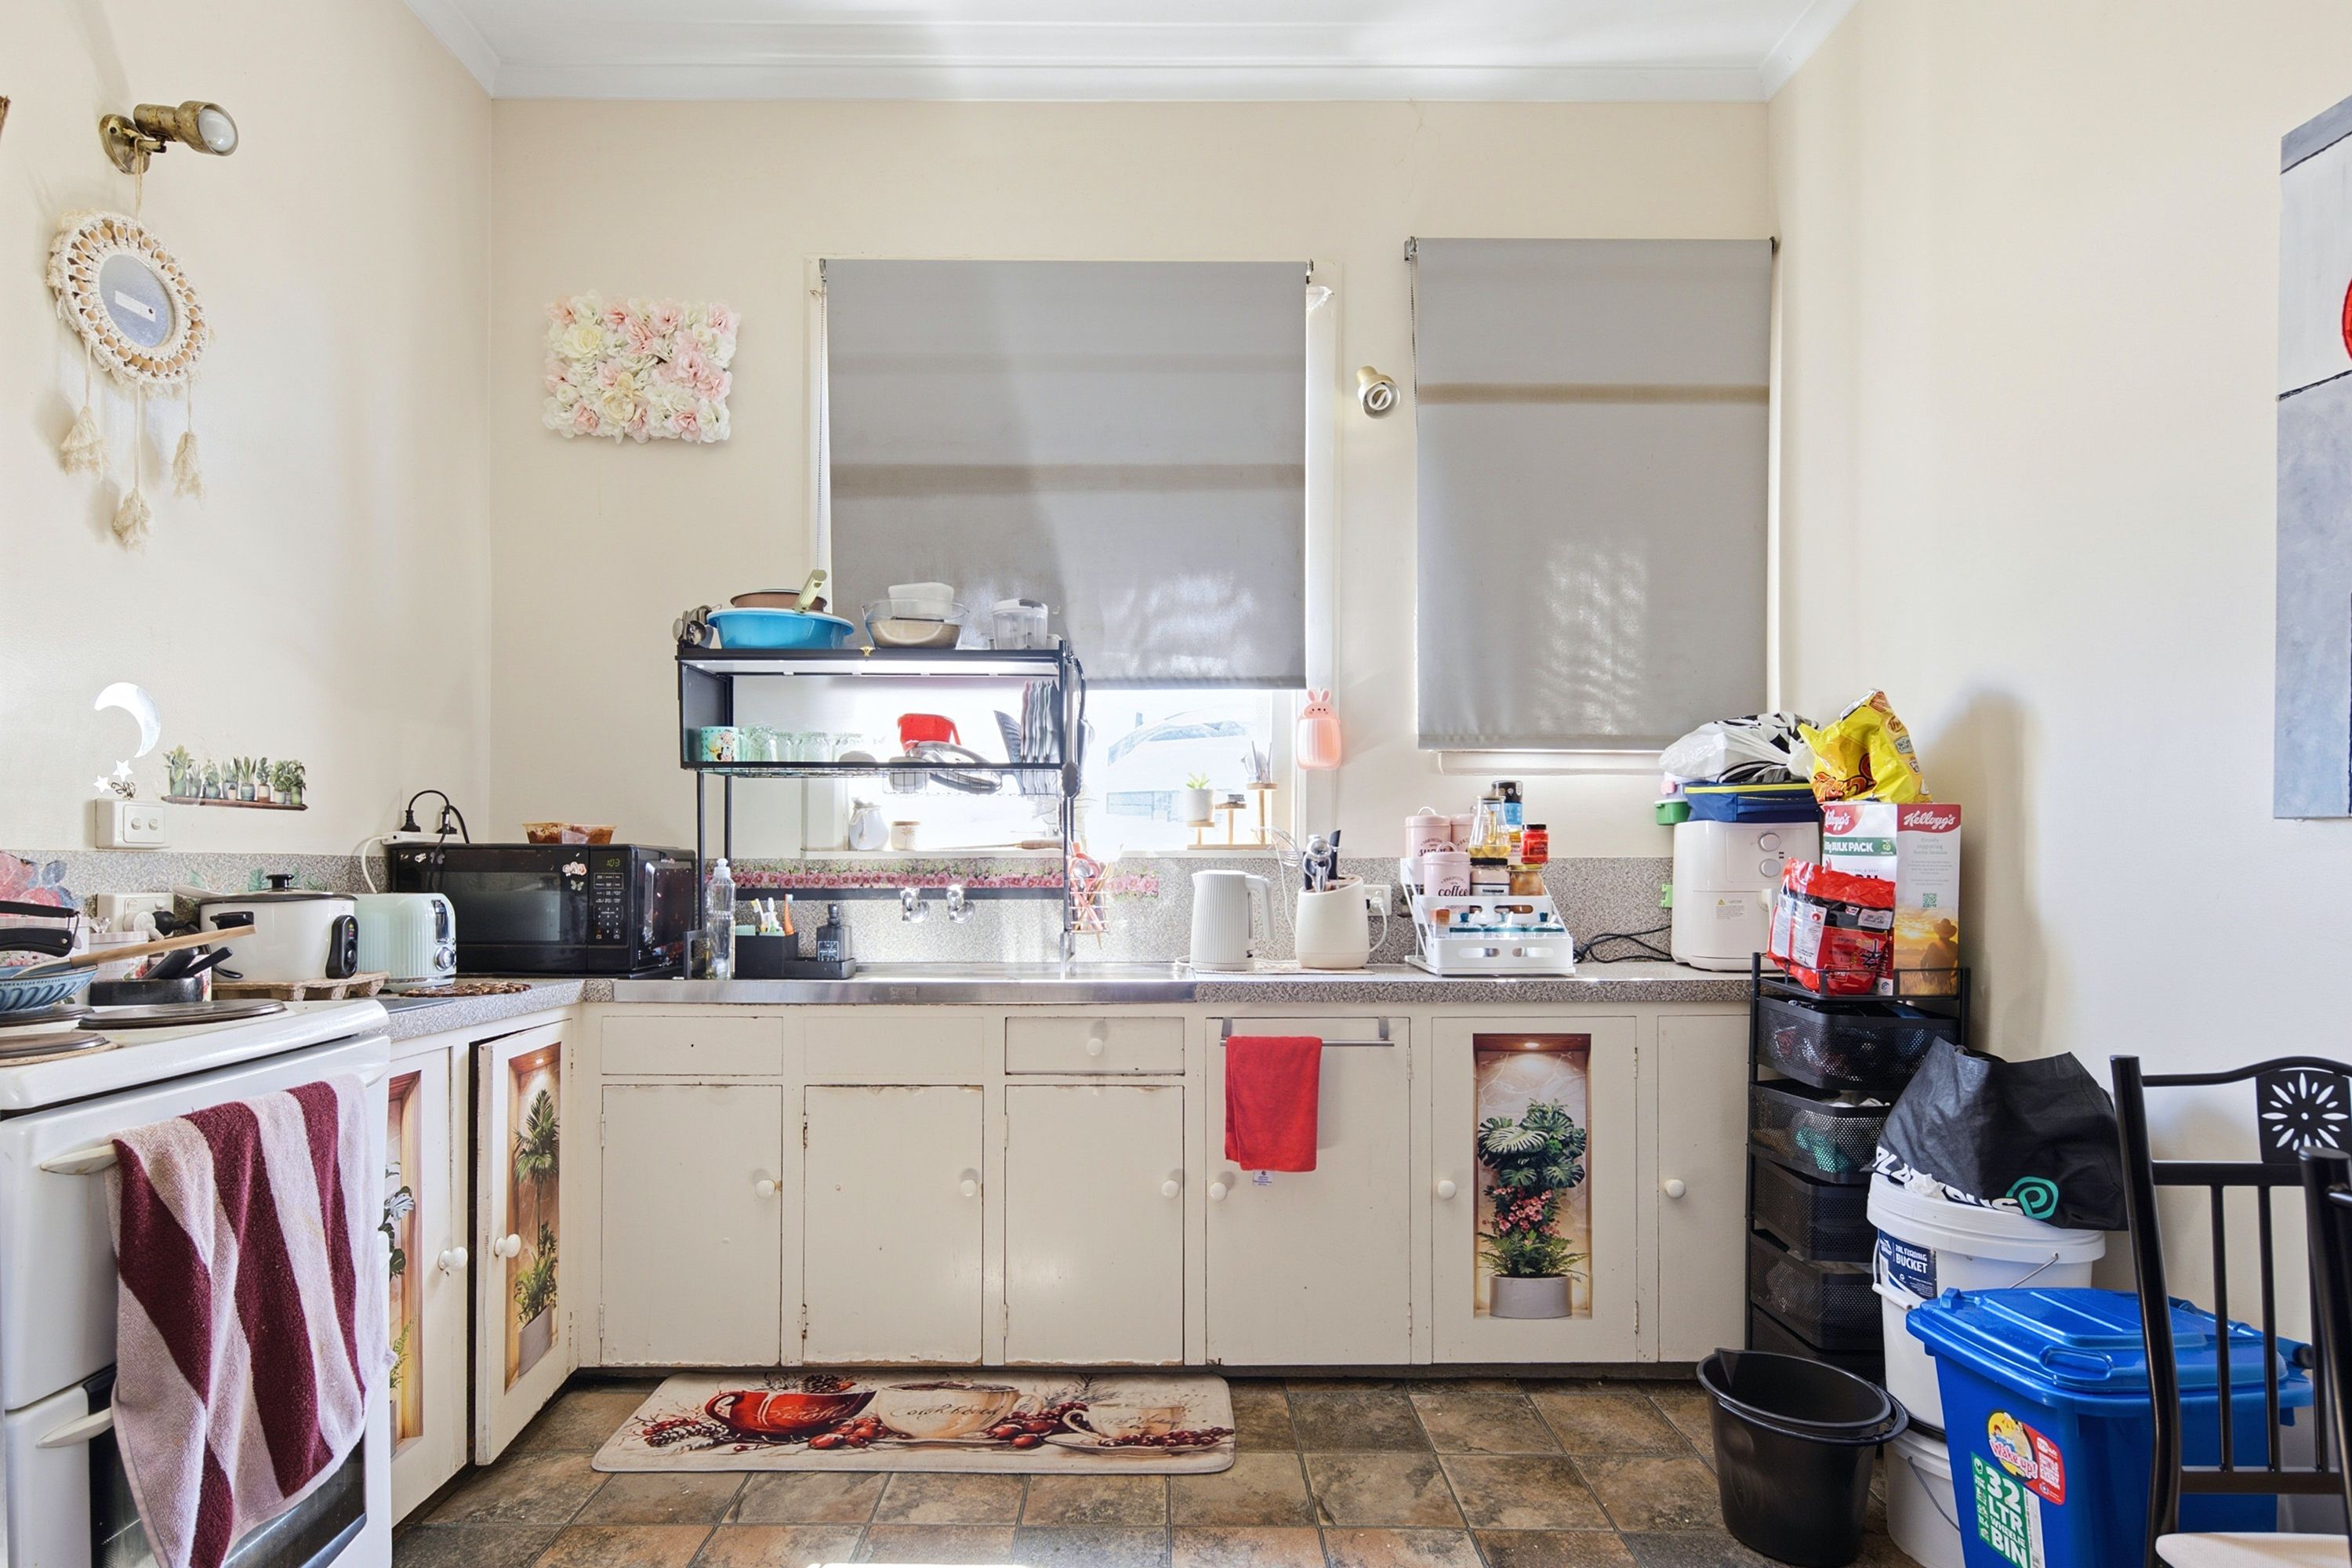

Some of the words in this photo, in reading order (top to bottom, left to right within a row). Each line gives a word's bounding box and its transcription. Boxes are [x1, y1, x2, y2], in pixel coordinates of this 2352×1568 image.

[1904, 809, 1956, 830] Kellogg's
[1831, 841, 1848, 852] BULK
[1849, 842, 1874, 853] PACK
[1438, 885, 1468, 897] coffee
[1872, 1146, 2024, 1215] PLAPS
[1896, 1252, 1928, 1274] BUCKET
[1990, 1439, 2019, 1466] Wake
[2020, 1460, 2038, 1479] up!
[1986, 1466, 2022, 1514] 32
[1988, 1495, 2025, 1538] LTR
[1991, 1515, 2026, 1549] WHEELIE
[1991, 1525, 2027, 1568] BIN
